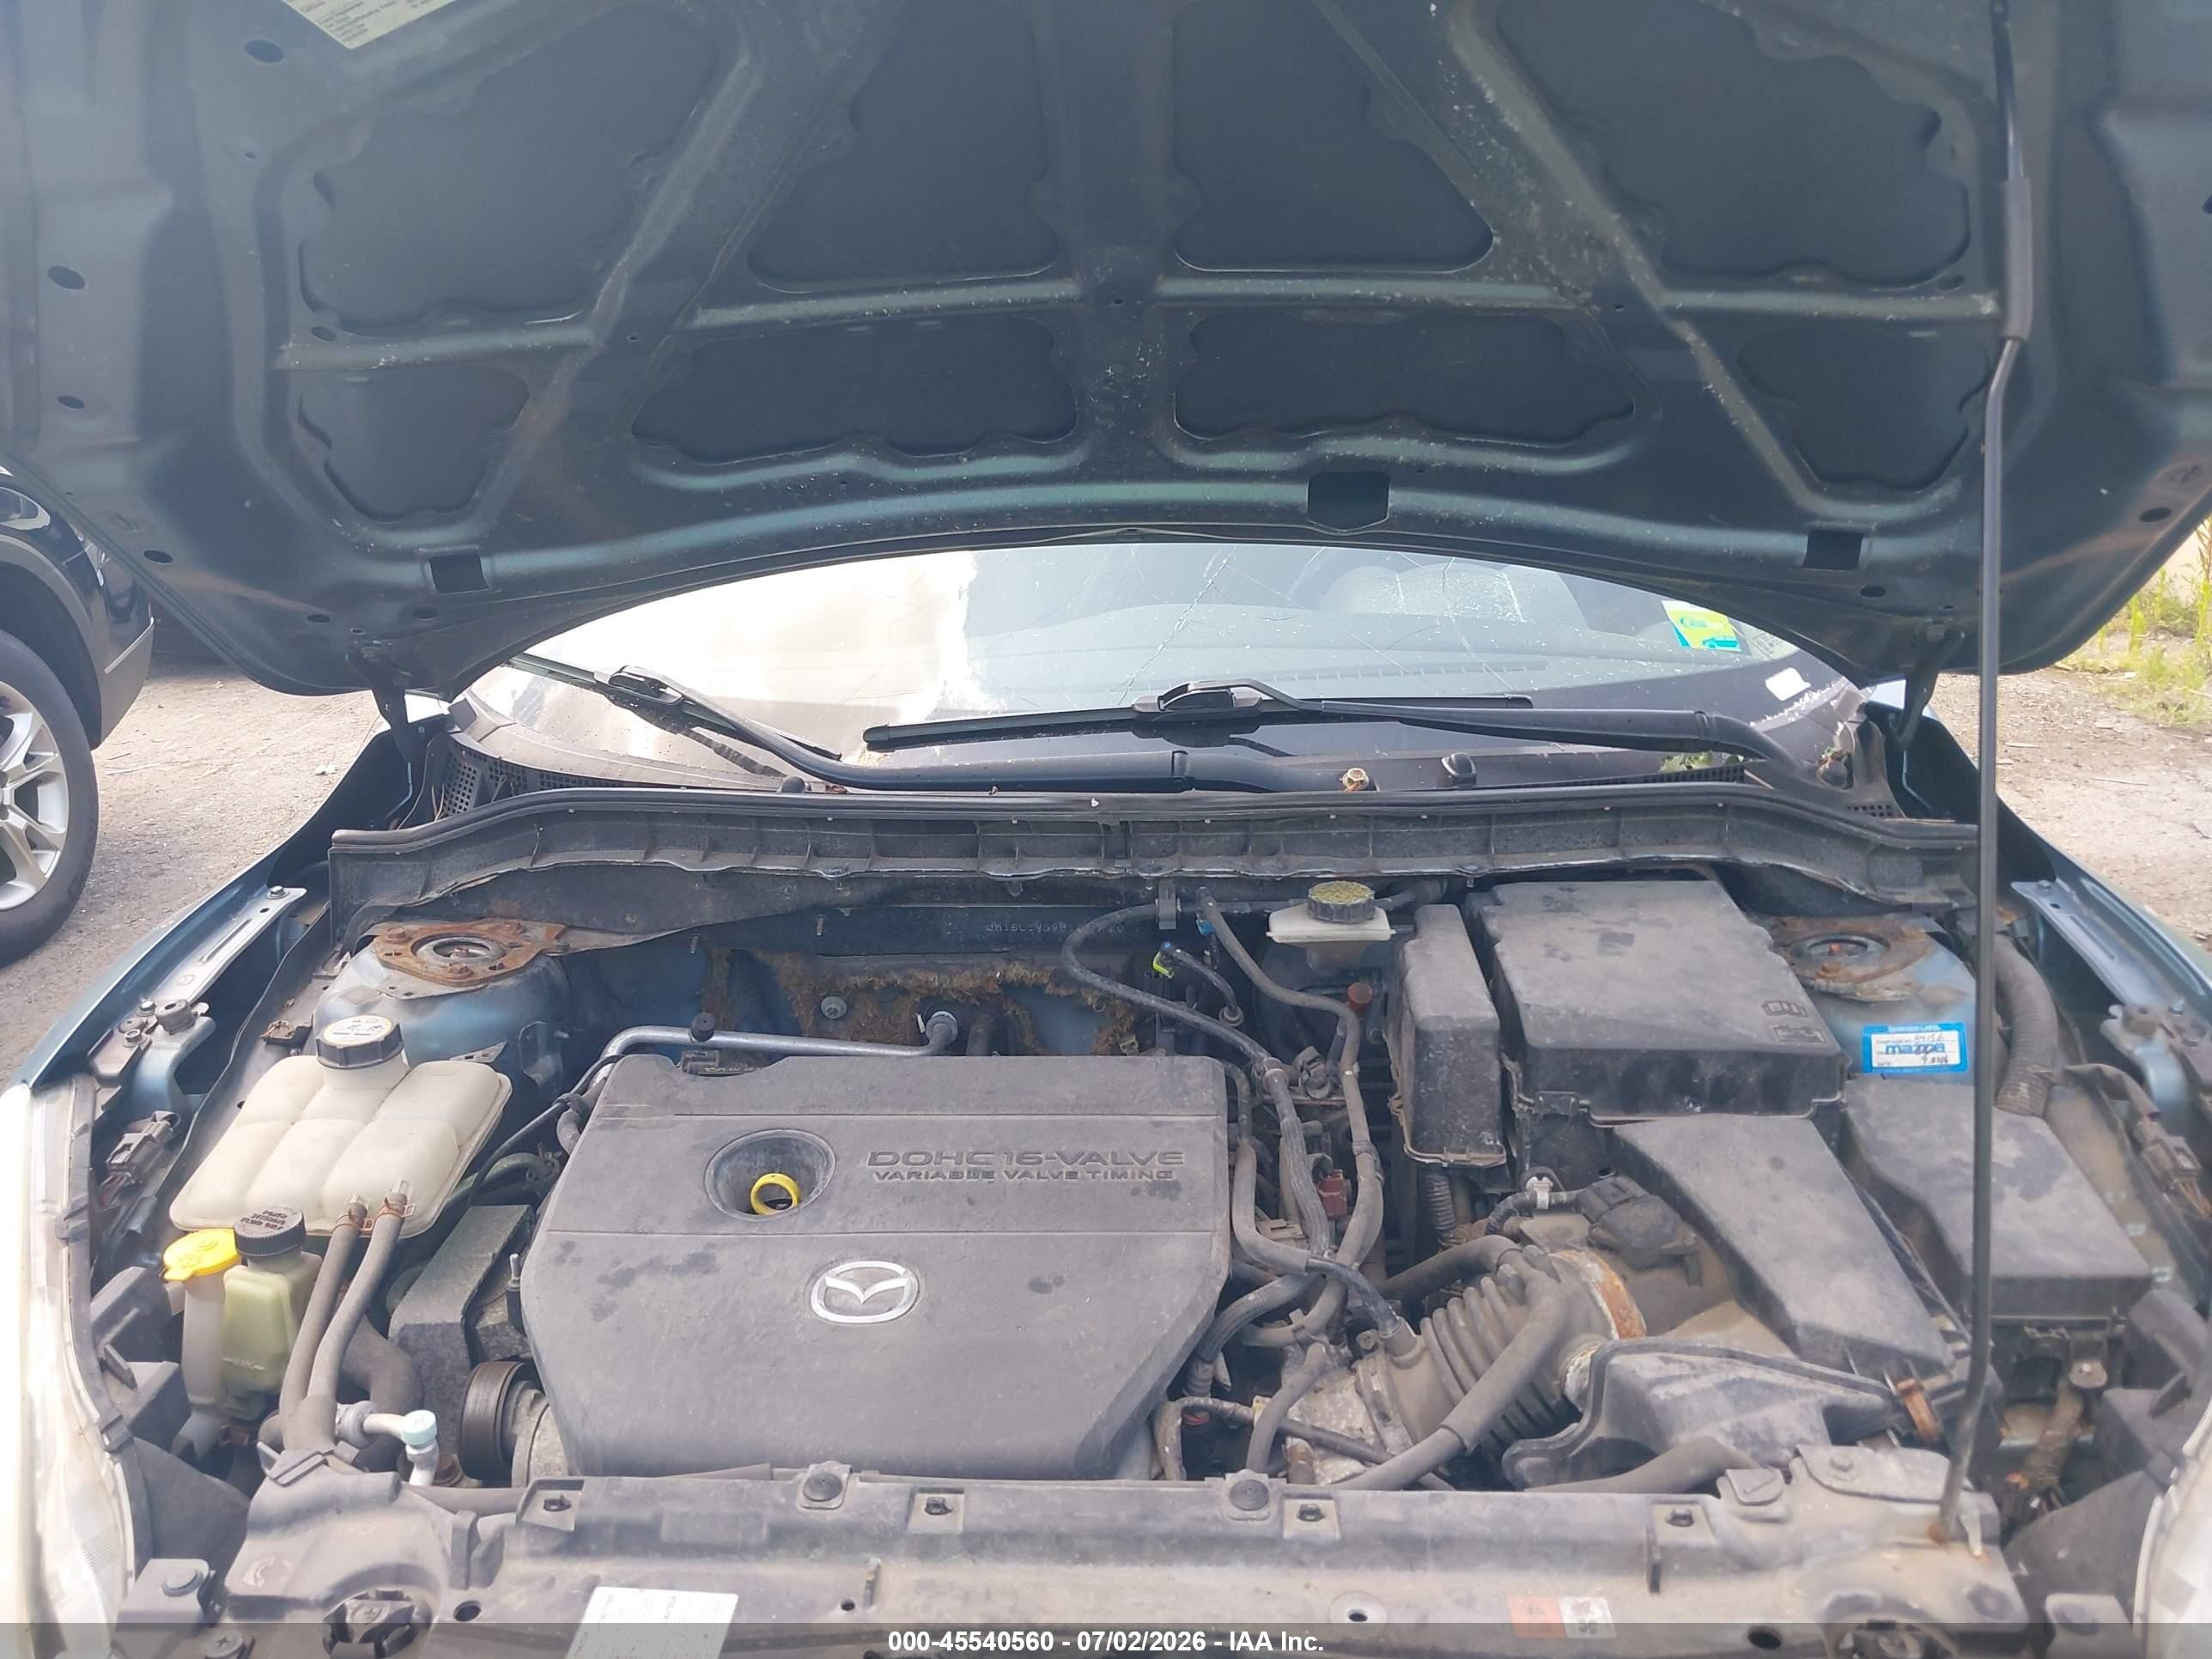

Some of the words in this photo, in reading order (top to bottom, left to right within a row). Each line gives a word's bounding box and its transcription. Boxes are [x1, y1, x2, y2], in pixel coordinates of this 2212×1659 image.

[1885, 1042, 1946, 1054] mazda
[867, 1151, 996, 1166] DOHC
[1003, 1151, 1185, 1166] 16-VALVE
[874, 1170, 995, 1182] VARIABLE
[1004, 1170, 1079, 1181] VALVE
[1087, 1170, 1176, 1181] TIMING
